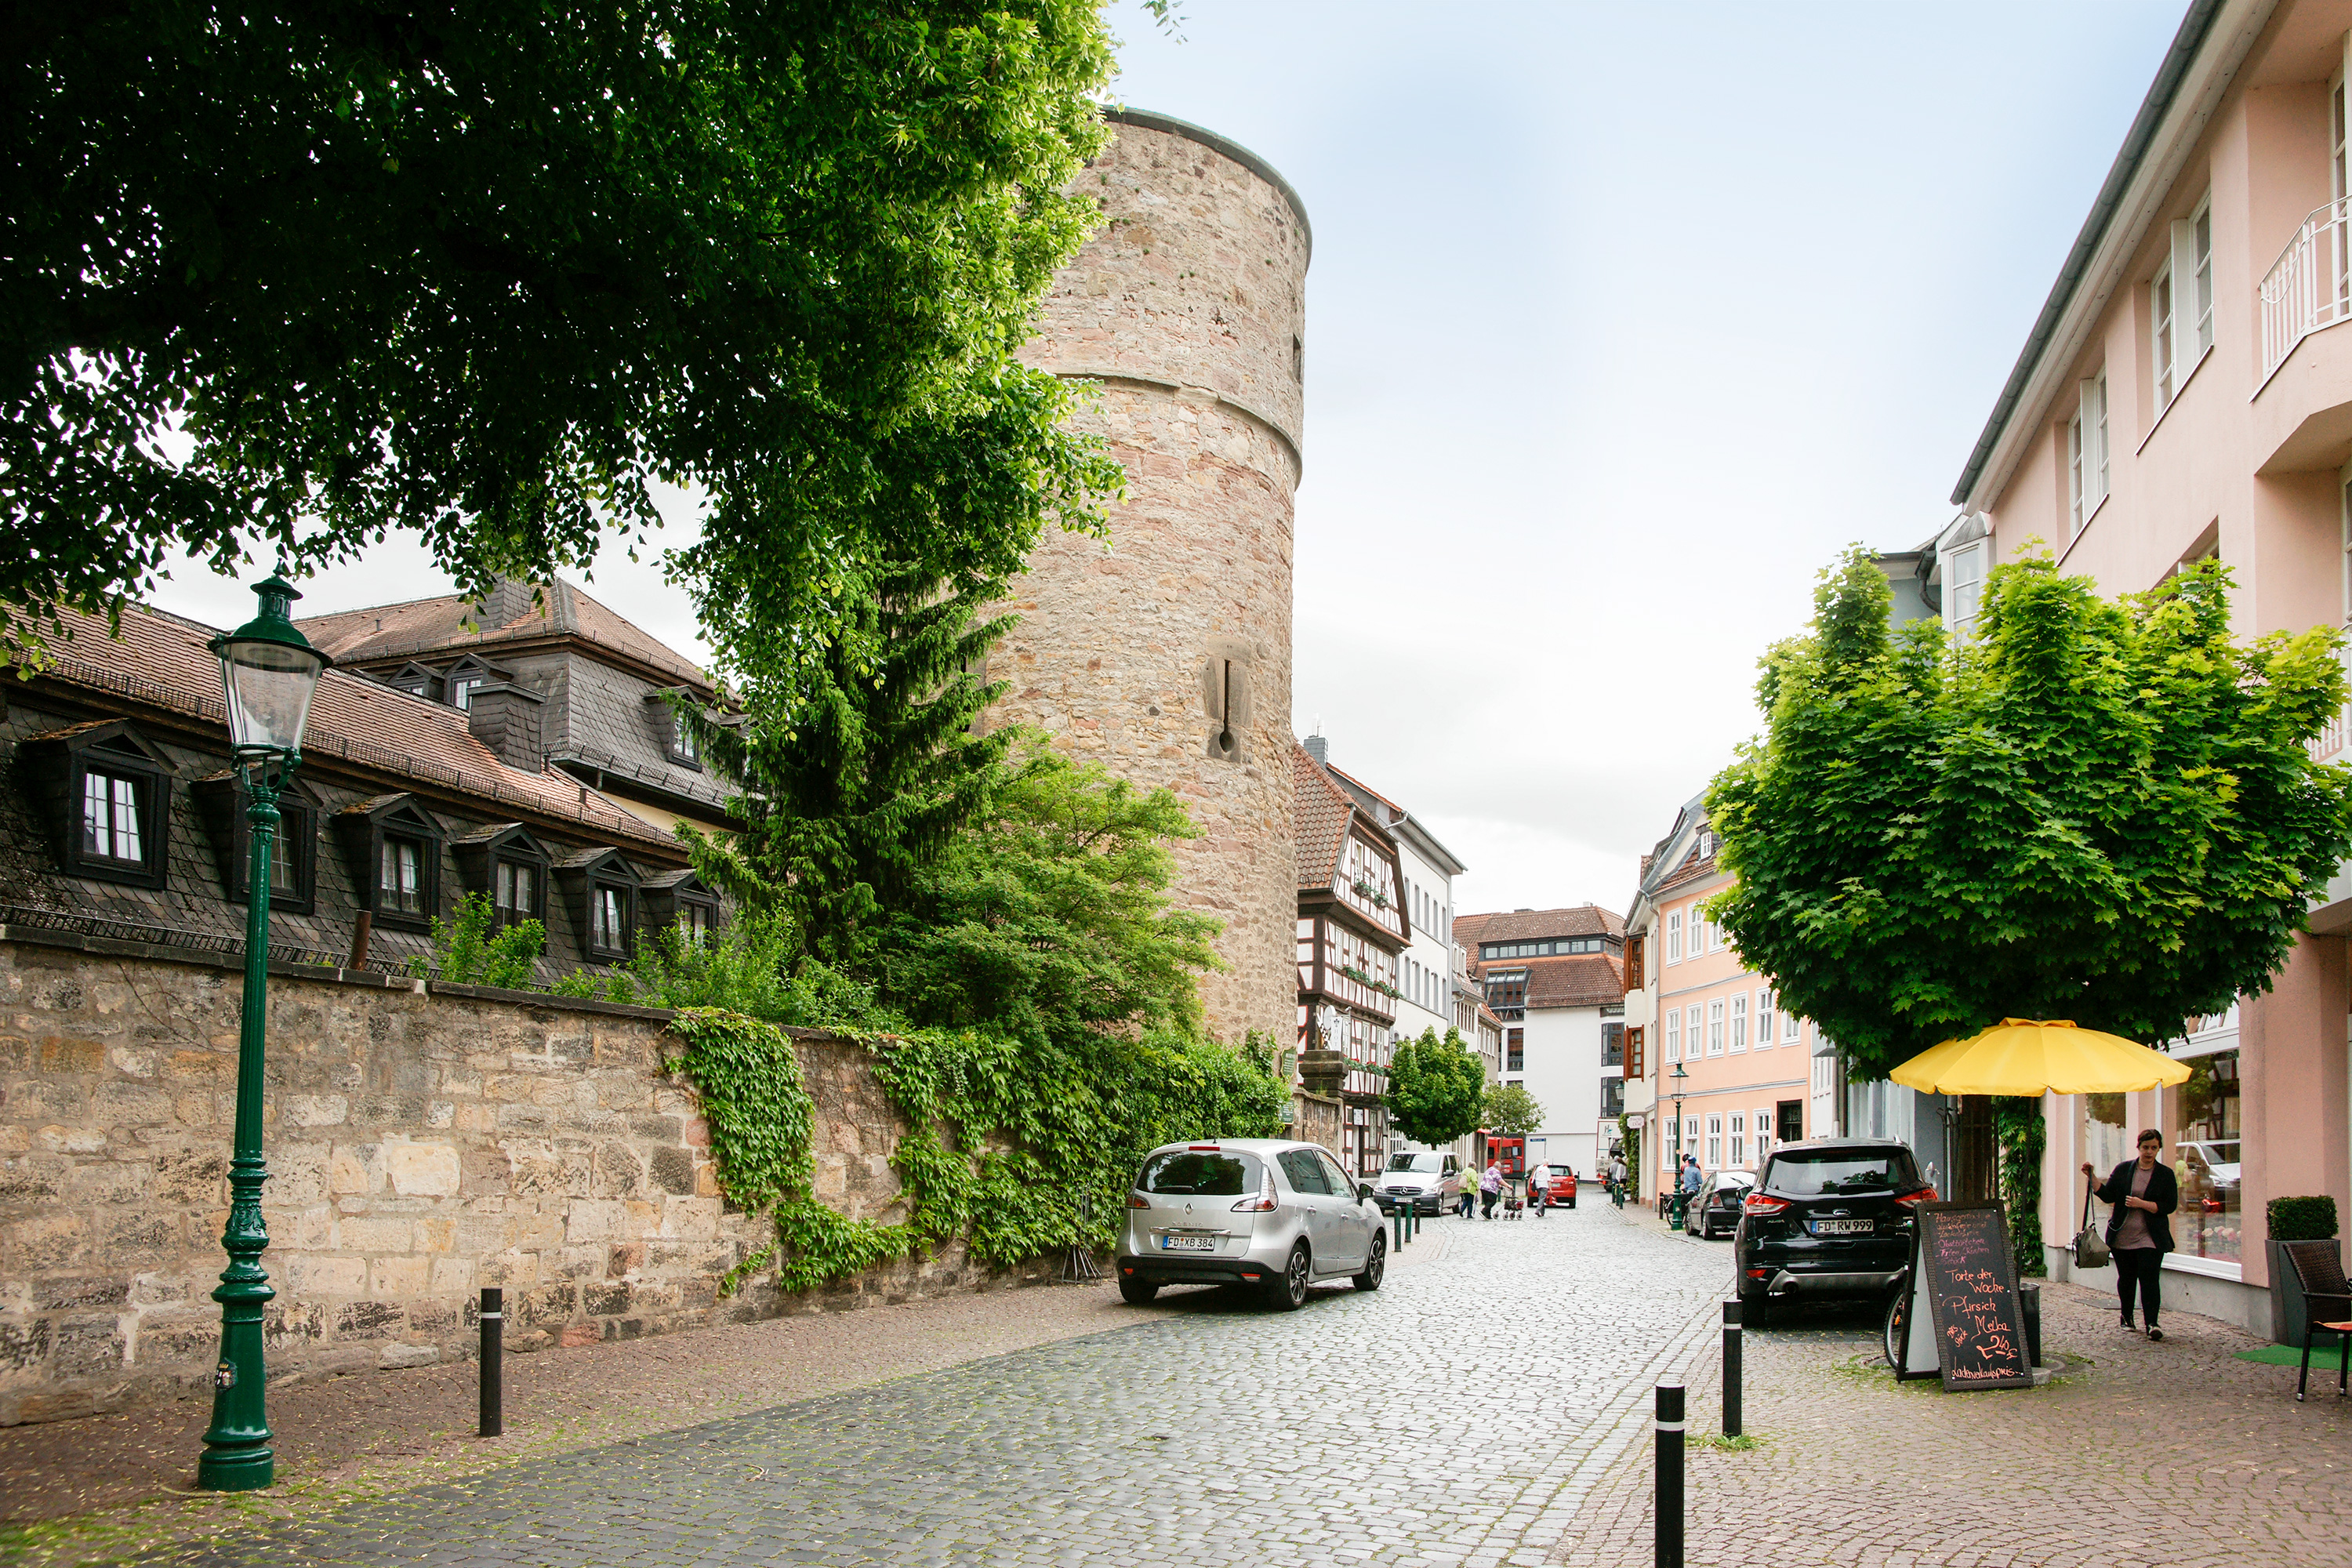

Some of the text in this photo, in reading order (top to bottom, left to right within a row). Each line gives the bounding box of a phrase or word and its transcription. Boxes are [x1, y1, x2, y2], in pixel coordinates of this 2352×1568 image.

[1817, 1220, 1873, 1232] FD RW 999
[1167, 1237, 1213, 1248] FD XB 384
[1945, 1268, 1993, 1283] Torte der
[1969, 1277, 2005, 1294] Woche
[1942, 1295, 1996, 1319] Pfirsich
[1970, 1315, 2012, 1342] Melba
